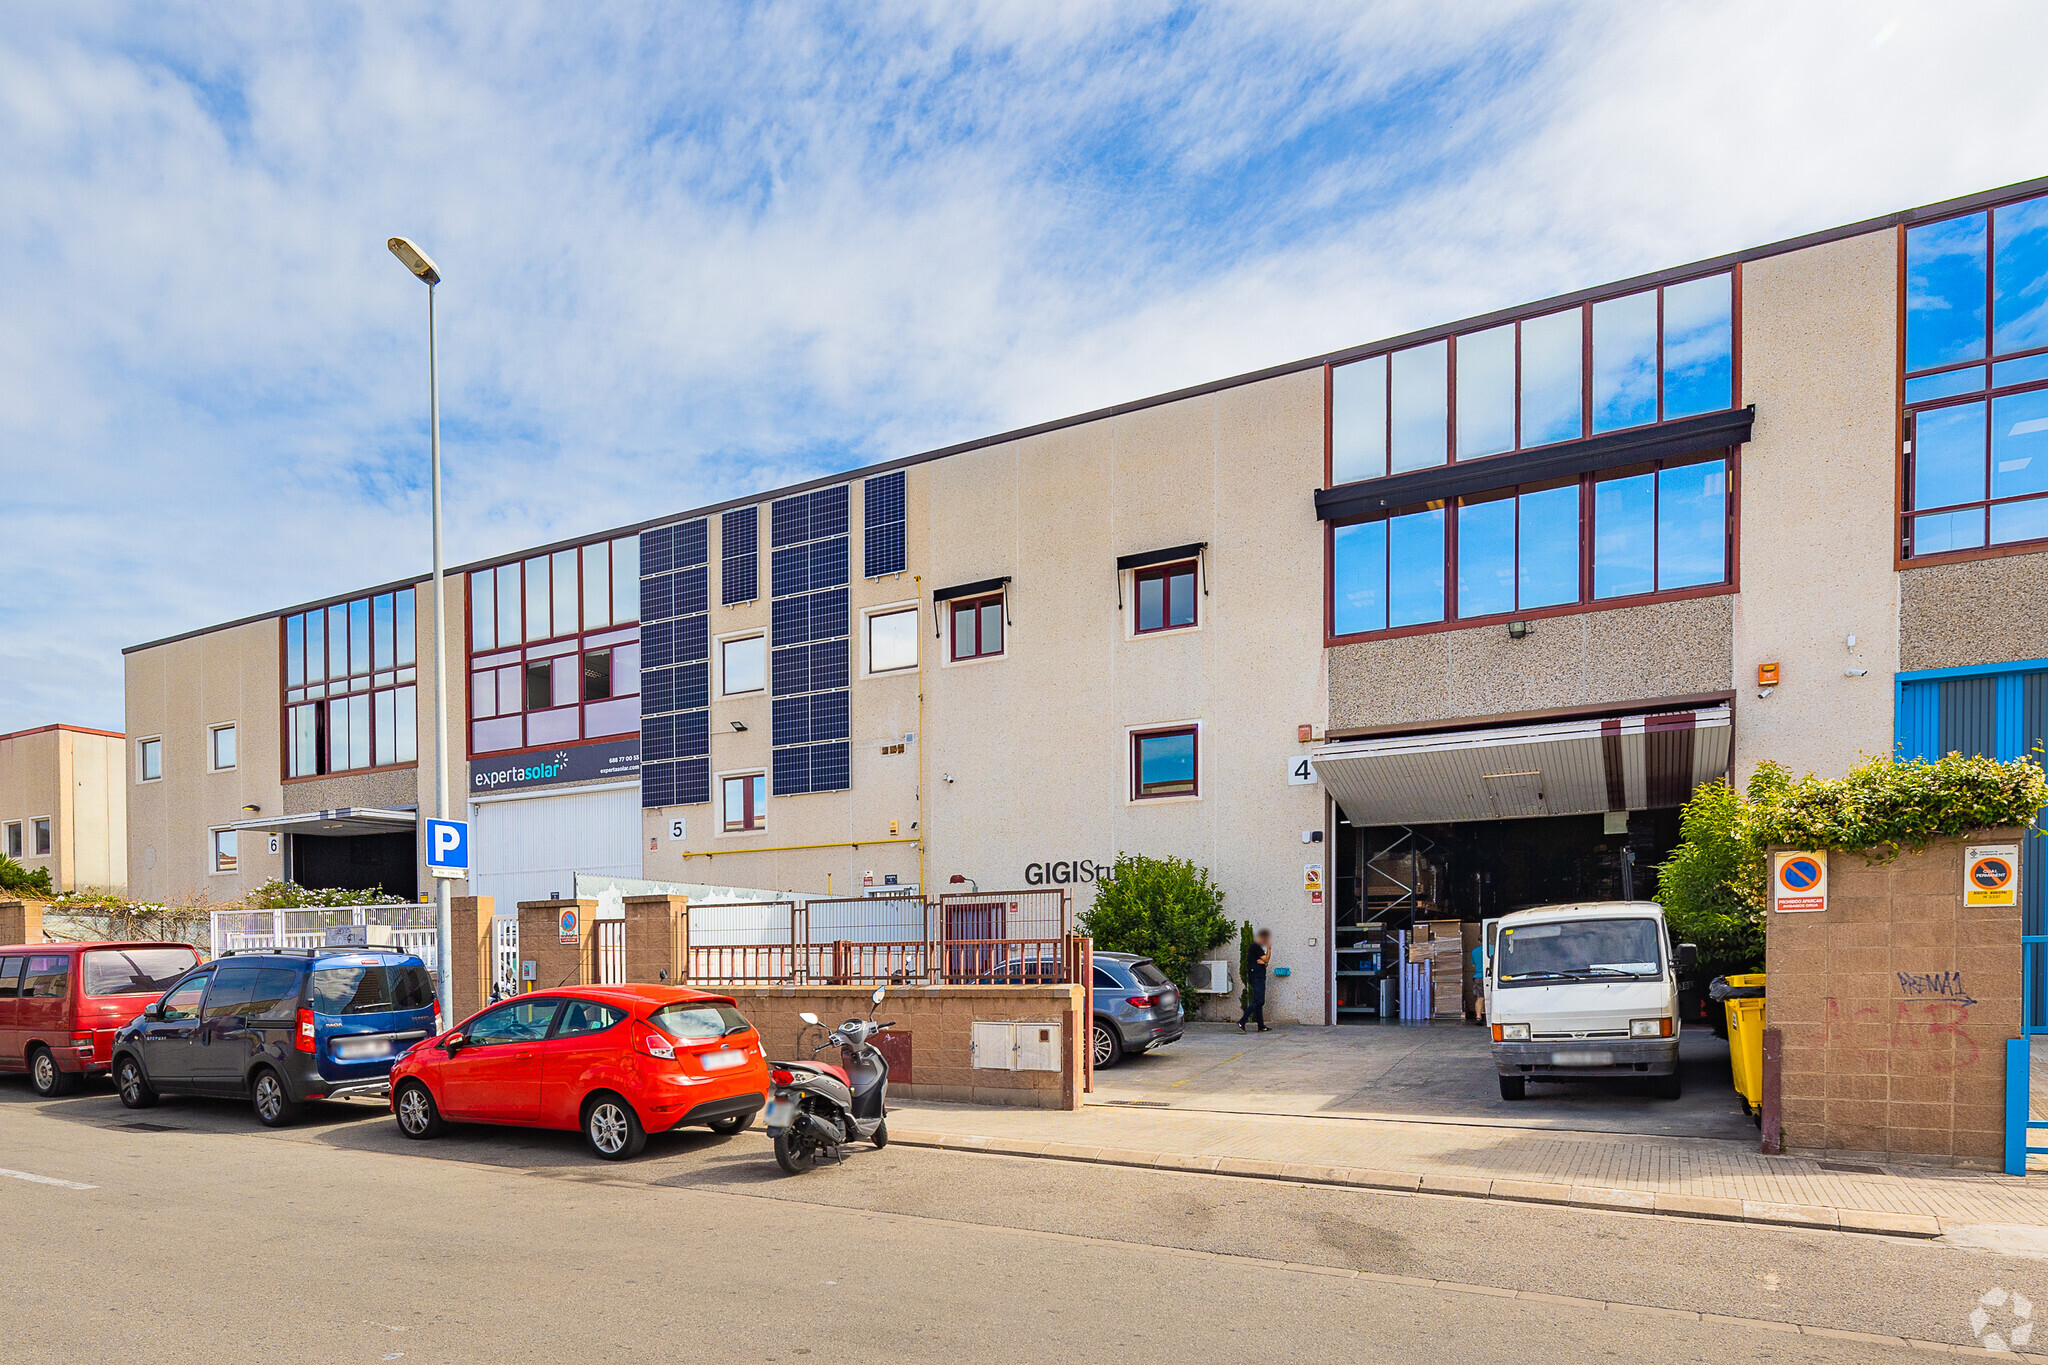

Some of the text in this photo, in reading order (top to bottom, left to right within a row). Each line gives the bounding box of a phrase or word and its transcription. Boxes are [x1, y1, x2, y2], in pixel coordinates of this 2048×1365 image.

[475, 762, 560, 788] expertasolar
[600, 765, 640, 774] expertasolar.com
[1294, 759, 1311, 780] 4
[672, 821, 683, 838] 5
[270, 838, 278, 852] 6
[434, 824, 460, 862] P
[1024, 860, 1123, 886] GIGIStu
